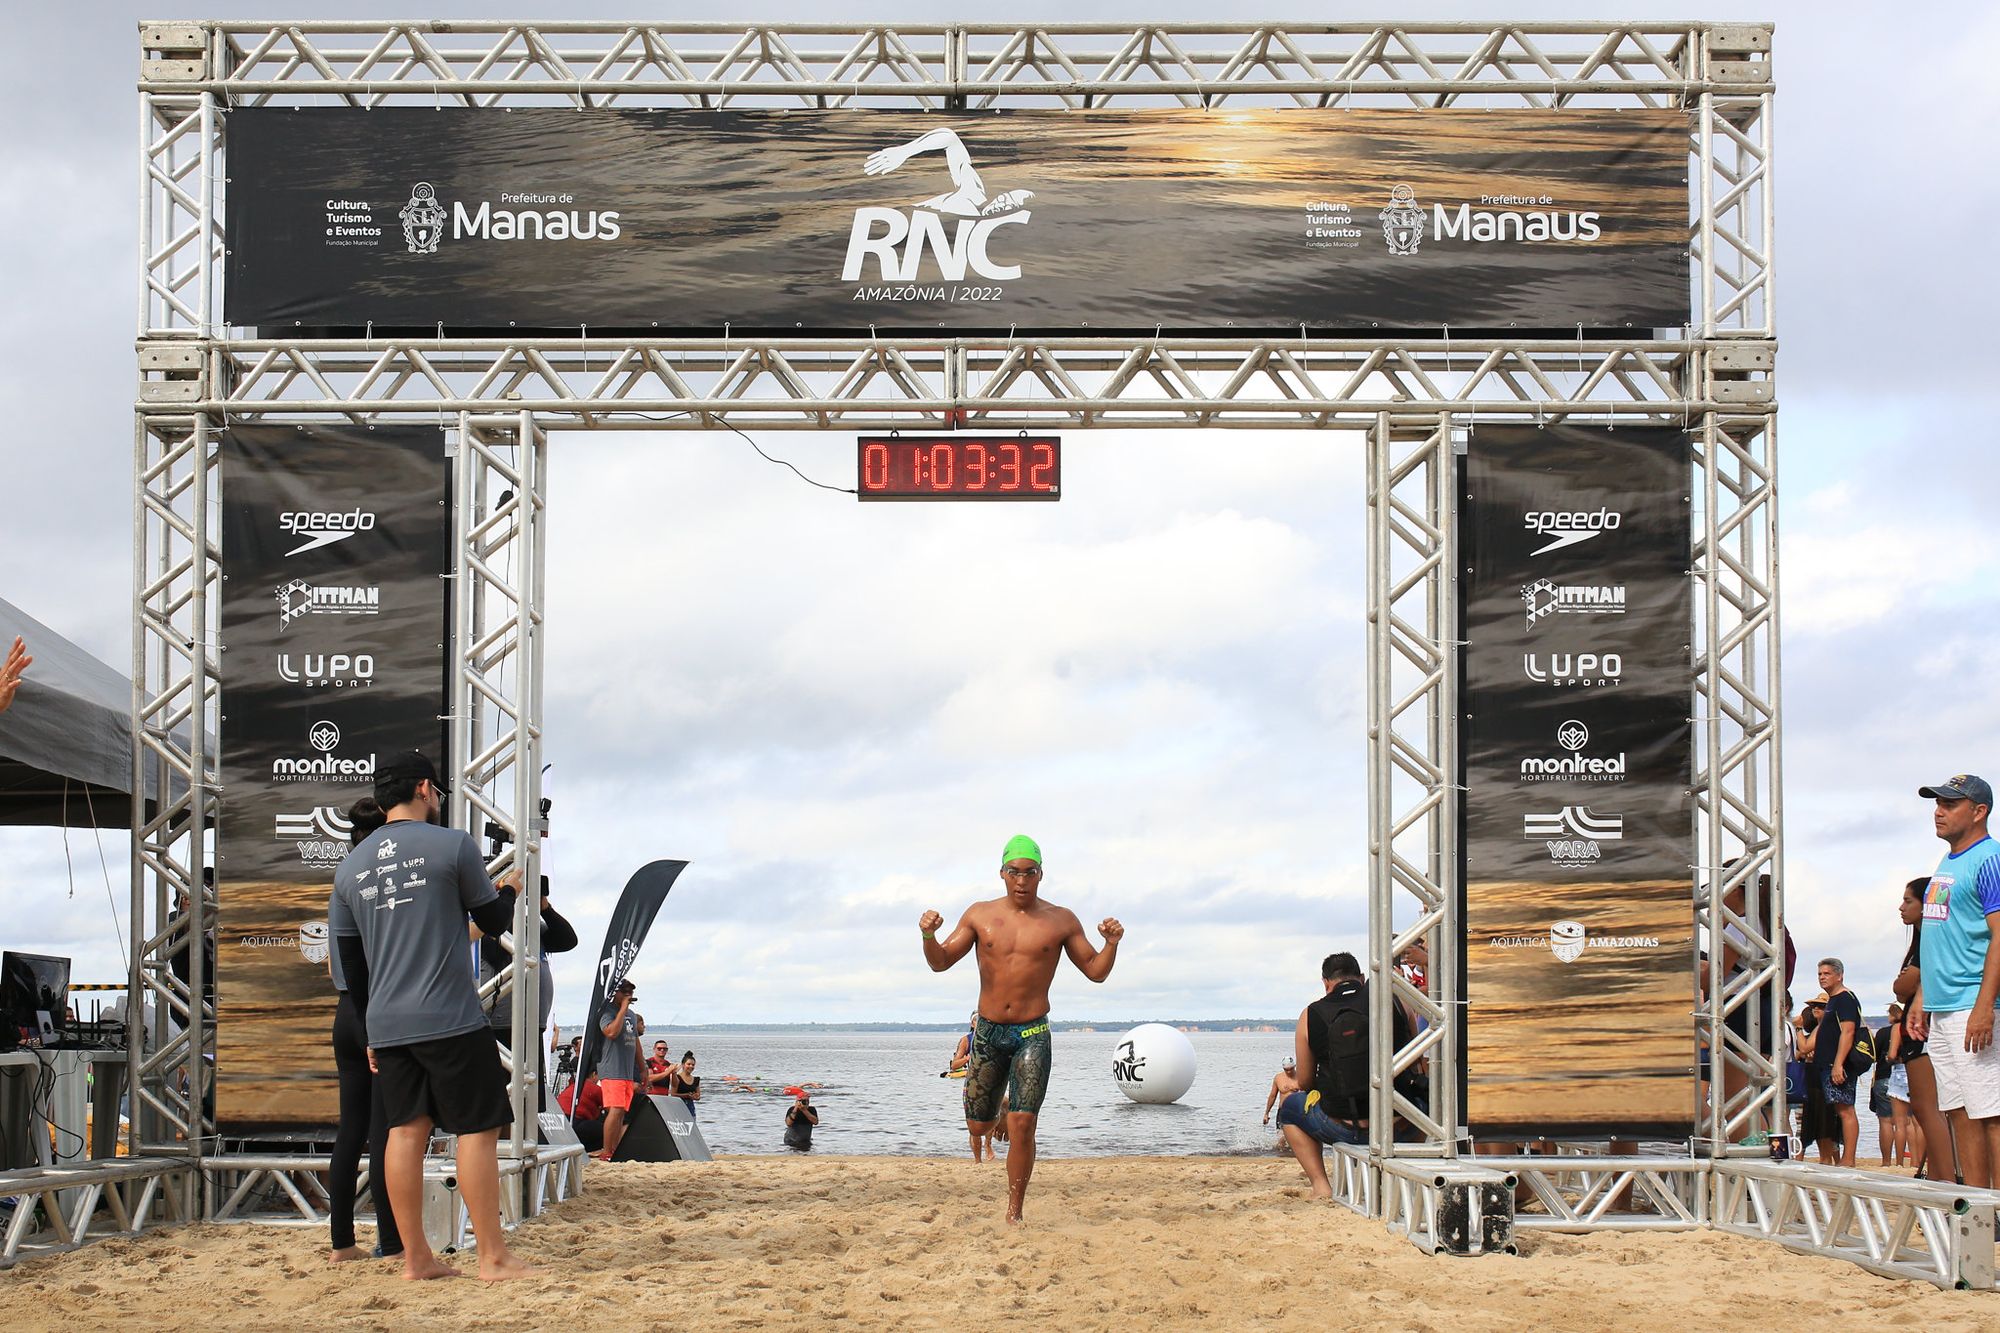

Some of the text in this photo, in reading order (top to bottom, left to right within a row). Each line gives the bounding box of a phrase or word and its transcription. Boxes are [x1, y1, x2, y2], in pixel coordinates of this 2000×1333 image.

[326, 199, 371, 212] Cultura,
[501, 192, 574, 204] Prefeitura de
[1481, 194, 1553, 206] Prefeitura de
[1305, 201, 1351, 213] Cultura,
[325, 212, 372, 223] Turismo
[453, 201, 621, 241] Manaus
[1305, 213, 1352, 225] Turismo
[1433, 203, 1601, 241] Manaus
[325, 225, 382, 236] e Eventos
[1305, 227, 1362, 238] e Eventos
[352, 239, 379, 247] Municipal
[841, 207, 1031, 281] RNC
[853, 284, 946, 301] AMAZÔNIA
[959, 287, 1003, 301] 2022
[279, 507, 375, 535] speedo
[1524, 506, 1621, 535] speedo
[277, 654, 375, 683] LUPO
[1523, 653, 1622, 683] LUPO
[306, 679, 373, 688] SPORT
[1553, 678, 1621, 687] SPORT
[272, 753, 376, 774] montreal
[1520, 752, 1626, 774] montreal
[296, 841, 350, 859] YARA
[1546, 840, 1601, 859] YARA
[240, 935, 296, 948] AQUÁTICA
[1490, 935, 1659, 948] AQUÁTICA AMAZONAS
[1113, 1060, 1146, 1081] RNC
